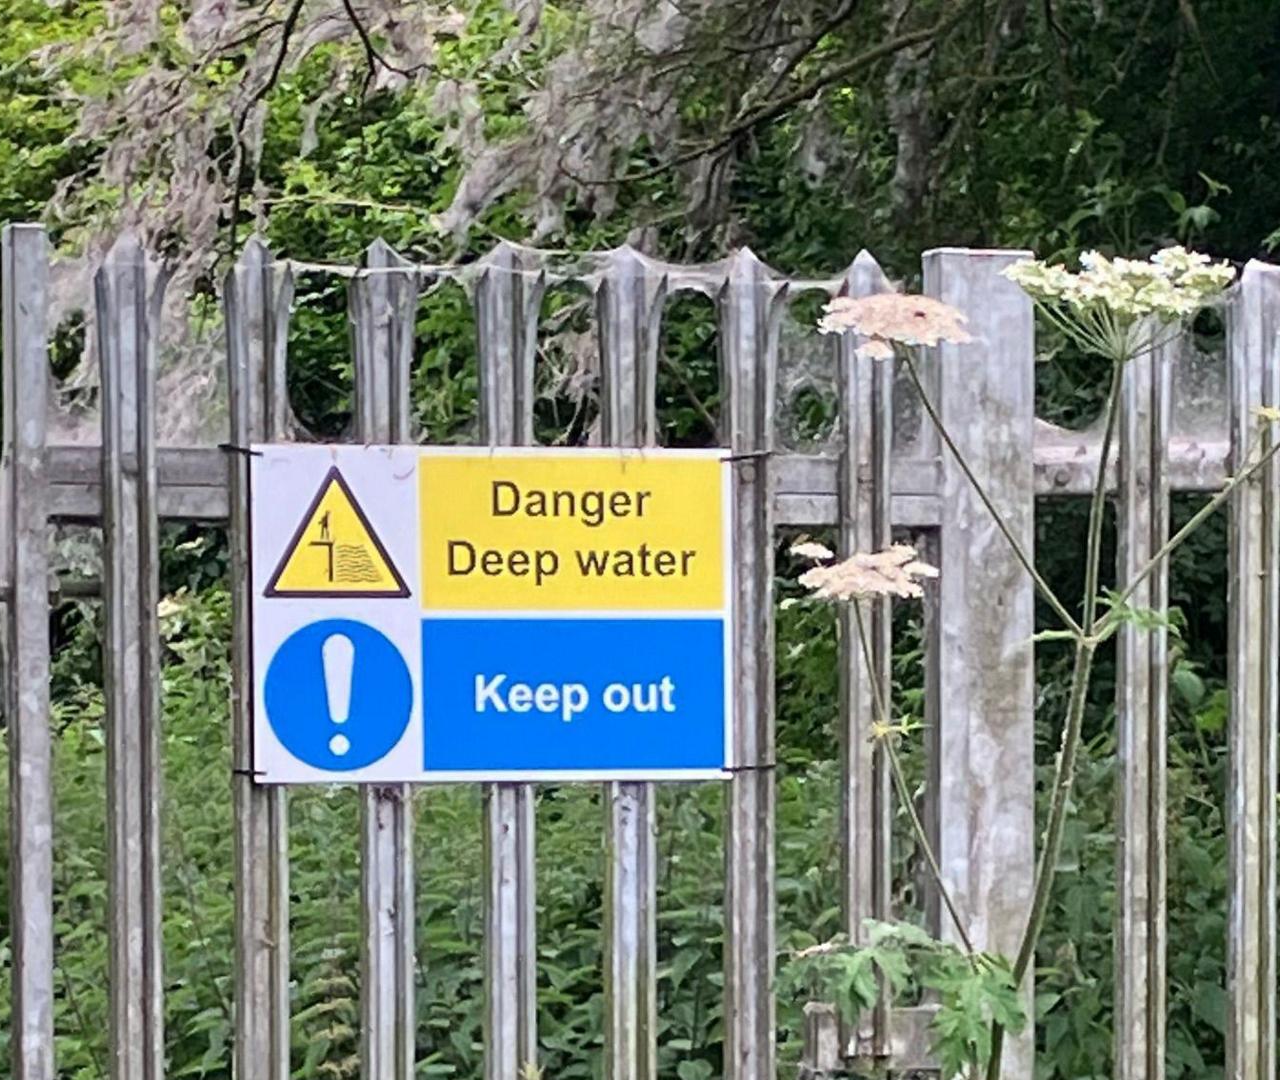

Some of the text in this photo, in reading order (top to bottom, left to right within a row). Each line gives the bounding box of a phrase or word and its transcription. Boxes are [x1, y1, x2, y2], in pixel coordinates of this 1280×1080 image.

[492, 481, 651, 527] Danger
[448, 540, 697, 586] Deep water
[475, 674, 676, 722] Keep out
